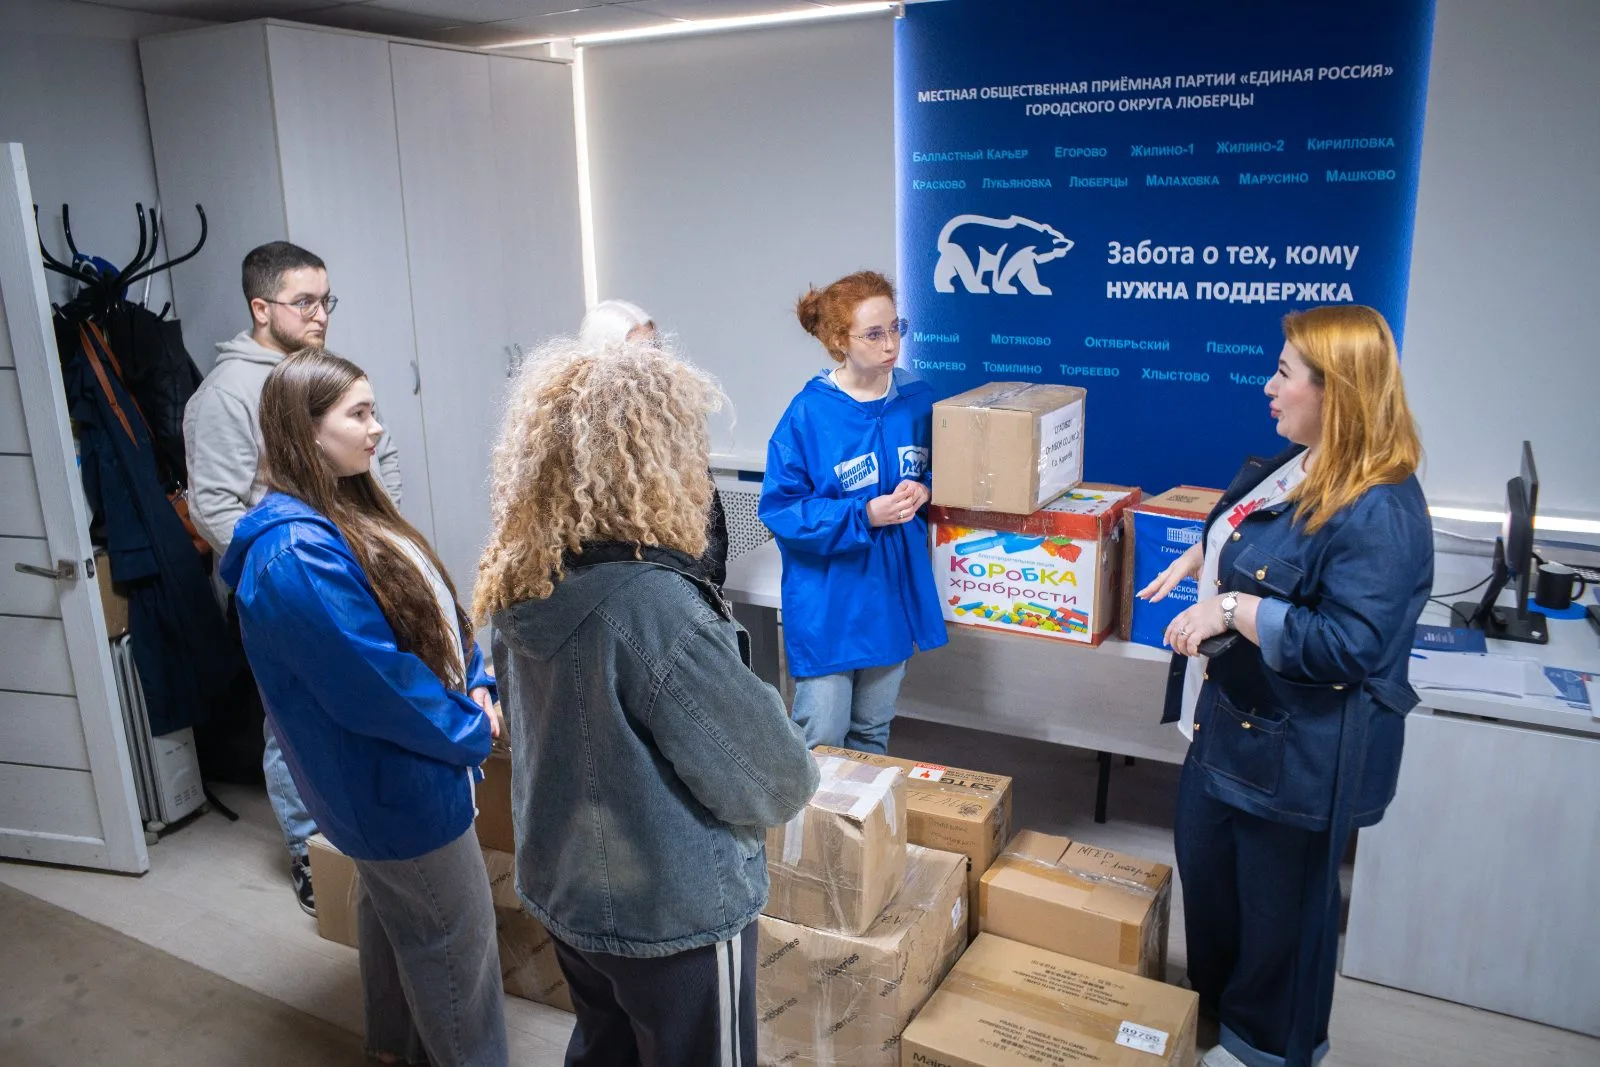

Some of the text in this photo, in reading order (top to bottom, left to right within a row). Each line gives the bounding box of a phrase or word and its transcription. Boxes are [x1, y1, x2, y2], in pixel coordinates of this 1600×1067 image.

[917, 63, 1394, 103] МЕСТНАЯ ОБЩЕСТВЕННАЯ ПРИЁМНАЯ ПАРТИИ «ЕДИНАЯ РОССИЯ»
[1025, 92, 1255, 118] ГОРОДСКОГО ОКРУГА ЛЮБЕРЦЫ
[1107, 239, 1360, 271] Забота о тех, кому
[1106, 280, 1354, 304] НУЖНА ПОДДЕРЖКА
[950, 577, 1077, 605] храбрости
[1167, 591, 1198, 602] МАНИТА
